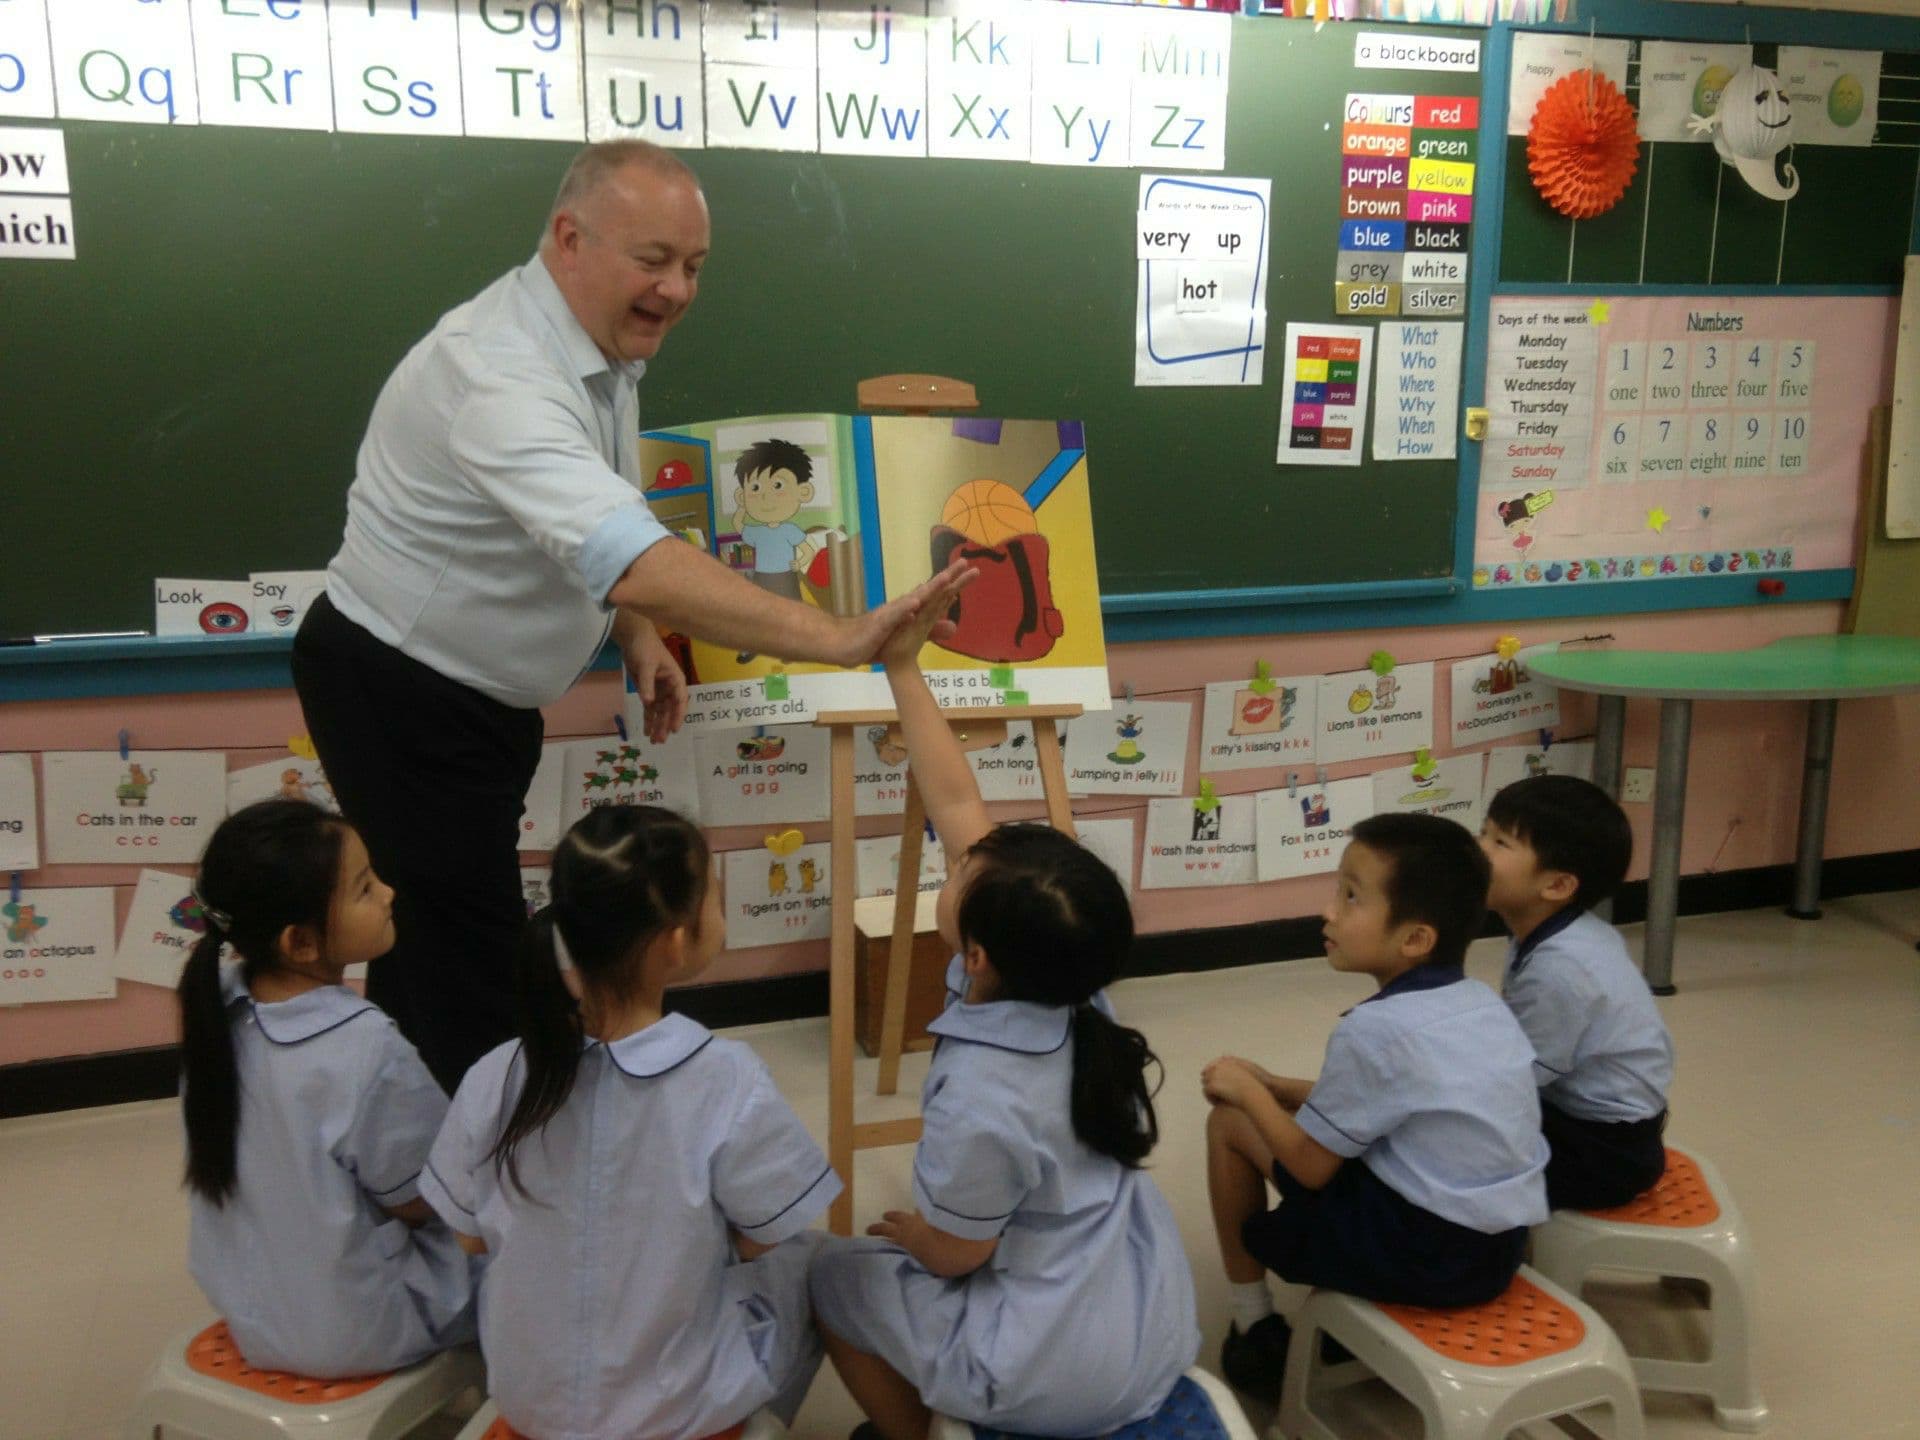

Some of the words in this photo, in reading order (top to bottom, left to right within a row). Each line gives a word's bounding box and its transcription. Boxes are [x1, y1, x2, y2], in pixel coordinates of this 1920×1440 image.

[480, 0, 562, 51] Gg
[606, 0, 681, 40] Hh
[853, 5, 892, 64] Jj
[951, 16, 1010, 65] Kk
[1360, 47, 1371, 59] a
[1380, 44, 1476, 64] blackboard
[79, 49, 178, 123] Qq
[231, 52, 303, 105] Rr
[362, 65, 438, 118] Ss
[495, 67, 555, 120] Tt
[609, 78, 683, 131] Uu
[727, 79, 797, 129] Vv
[826, 91, 921, 141] Ww
[949, 93, 1011, 140] Xx
[1052, 104, 1111, 162] Yy
[1150, 104, 1206, 149] Zz
[1429, 103, 1462, 123] red
[1346, 134, 1407, 157] orange
[1418, 139, 1468, 159] green
[1347, 164, 1402, 189] purple
[1415, 167, 1468, 187] yellow
[1347, 195, 1401, 216] brown
[1422, 199, 1457, 221] pink
[1143, 231, 1191, 253] very
[1218, 233, 1241, 254] up
[1354, 226, 1391, 246] blue
[1414, 227, 1460, 248] black
[1350, 262, 1390, 282] grey
[1411, 260, 1458, 279] white
[1182, 278, 1218, 299] hot
[1350, 285, 1388, 310] gold
[1410, 289, 1457, 308] silver
[1498, 314, 1523, 327] Days
[1526, 313, 1539, 325] of
[1543, 314, 1560, 325] the
[1563, 314, 1588, 325] week
[1686, 312, 1744, 332] Numbers
[1401, 326, 1439, 346] What
[1518, 334, 1568, 350] Monday
[1306, 344, 1320, 353] red
[1400, 351, 1437, 369] Who
[1516, 356, 1569, 373] Tuesday
[1621, 348, 1630, 371] 1
[1661, 347, 1675, 370] 2
[1705, 346, 1718, 369] 3
[1748, 346, 1761, 368] 4
[1790, 346, 1803, 368] 5
[1398, 375, 1436, 393] Where
[1504, 378, 1577, 395] Wednesday
[1609, 384, 1639, 400] one
[1651, 383, 1681, 399] two
[1690, 380, 1729, 398] three
[1736, 379, 1768, 397] four
[1780, 378, 1809, 396] five
[1302, 388, 1319, 398] blue
[1330, 390, 1352, 401] purple
[1399, 398, 1436, 415] Why
[1510, 400, 1569, 416] Thursday
[1398, 415, 1435, 435] When
[1517, 421, 1559, 438] Friday
[1613, 422, 1627, 445] 6
[1659, 420, 1671, 443] 7
[1705, 418, 1718, 441] 8
[1747, 418, 1760, 441] 9
[1783, 417, 1806, 440] 10
[1397, 438, 1434, 456] How
[1507, 443, 1566, 460] Saturday
[1606, 457, 1628, 474] six
[1640, 456, 1684, 472] seven
[1690, 452, 1728, 474] eight
[1734, 451, 1766, 469] nine
[1779, 452, 1802, 468] ten
[1511, 464, 1558, 480] Sunday
[158, 588, 204, 604] Look
[253, 582, 288, 600] Say
[953, 674, 964, 688] is
[968, 676, 977, 688] a
[696, 688, 735, 702] name
[739, 685, 752, 698] is
[955, 693, 967, 707] in
[971, 695, 992, 707] my
[684, 711, 705, 724] am
[709, 707, 730, 722] six
[735, 703, 777, 722] years
[1326, 718, 1355, 733] Lions
[1357, 715, 1378, 728] like
[1380, 709, 1424, 724] lemons
[1210, 742, 1242, 757] Kitty's
[1245, 740, 1281, 754] kissing
[713, 765, 724, 777] A
[728, 763, 750, 779] girl
[753, 763, 763, 775] is
[767, 762, 808, 776] going
[978, 758, 1004, 771] Inch
[1007, 758, 1034, 771] long
[854, 772, 882, 784] ands
[885, 772, 901, 783] on
[1071, 768, 1121, 783] Jumping
[1123, 769, 1133, 780] in
[1135, 769, 1159, 783] jelly
[639, 789, 664, 802] fish
[1431, 800, 1473, 817] yummy
[76, 812, 115, 827] Cats
[119, 814, 134, 827] in
[139, 814, 165, 827] the
[169, 815, 198, 827] car
[1281, 834, 1301, 848] Fox
[1304, 831, 1315, 844] in
[1317, 831, 1326, 842] a
[1151, 845, 1182, 856] Wash
[1185, 843, 1205, 856] the
[1206, 842, 1256, 855] windows
[740, 901, 780, 918] Tigers
[783, 900, 802, 911] on
[152, 930, 185, 949] Pink
[3, 948, 25, 960] an
[29, 944, 97, 959] octopus
